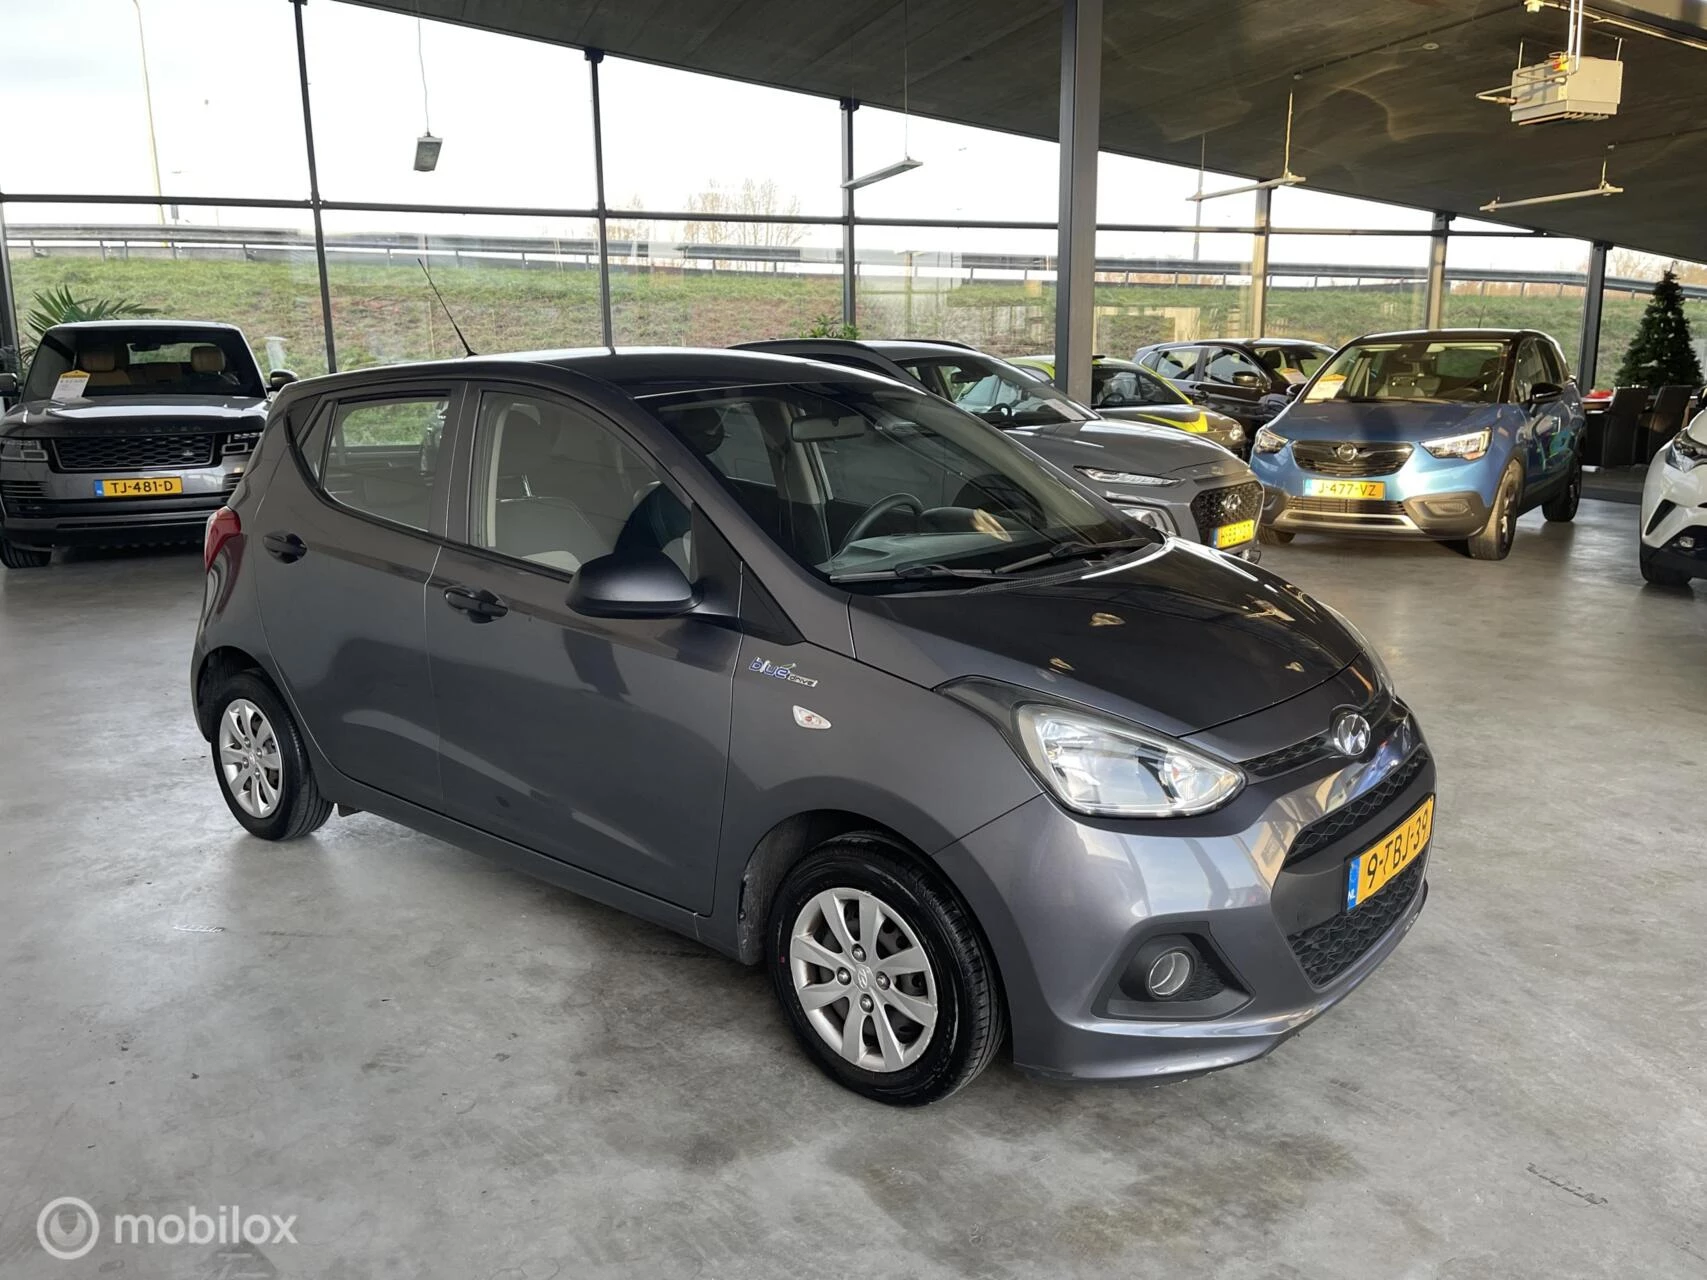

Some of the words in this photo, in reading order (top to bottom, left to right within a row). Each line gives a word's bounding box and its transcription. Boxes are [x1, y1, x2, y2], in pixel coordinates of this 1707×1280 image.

[110, 480, 173, 494] TJ-481-D
[1318, 483, 1377, 496] J-477-VZ
[749, 657, 790, 679] blue
[1367, 808, 1429, 889] 9-TBJ-39
